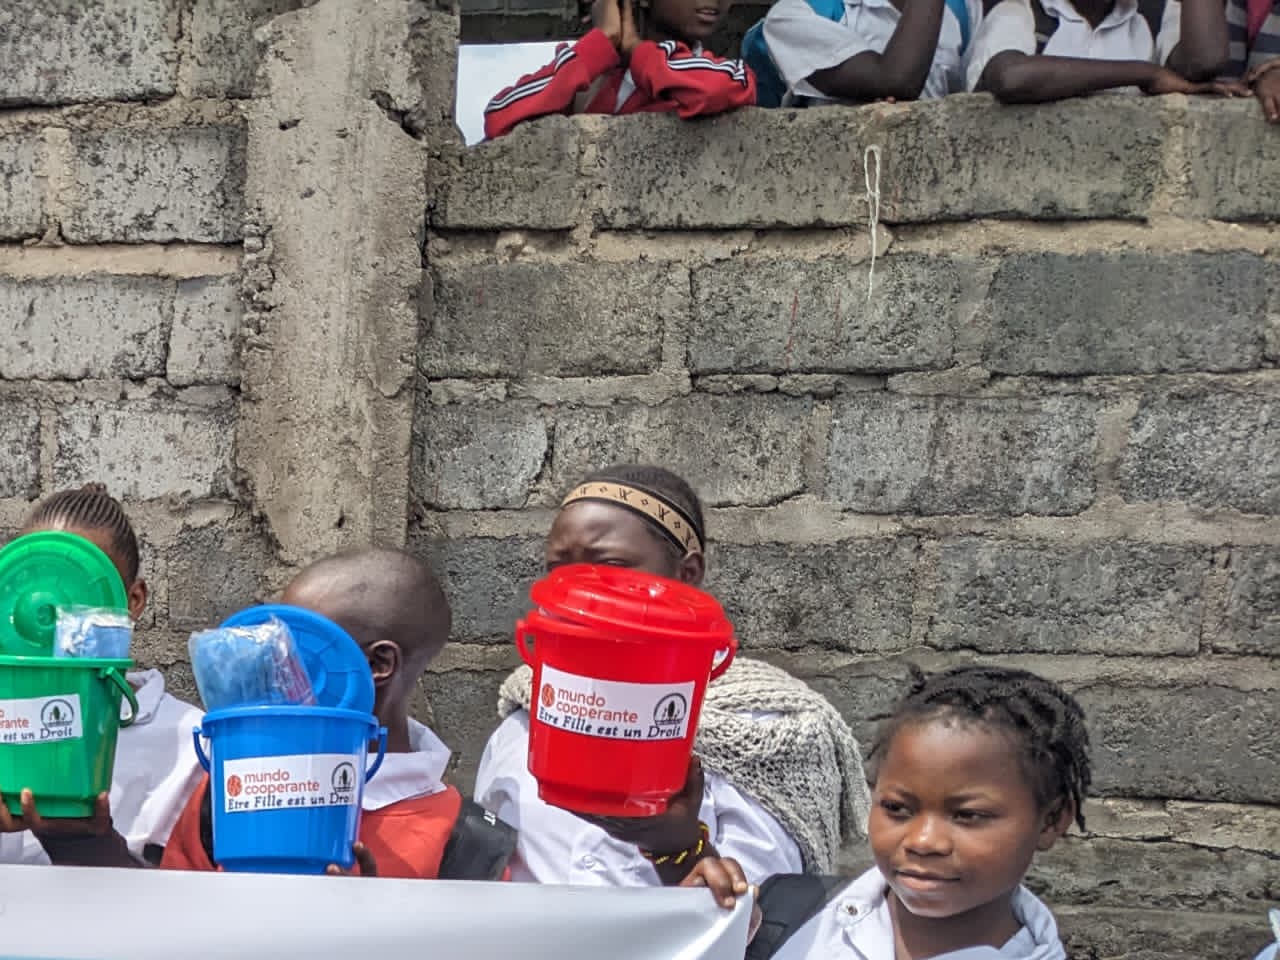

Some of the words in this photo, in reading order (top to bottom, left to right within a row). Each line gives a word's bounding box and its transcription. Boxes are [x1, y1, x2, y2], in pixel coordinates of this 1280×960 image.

[557, 687, 606, 707] mundo
[556, 700, 638, 724] cooperante
[539, 706, 559, 724] Etre
[562, 715, 593, 732] Fille
[597, 725, 618, 737] est
[623, 727, 642, 738] un
[647, 725, 681, 738] Droit
[40, 727, 73, 739] Droit
[244, 769, 290, 783] mundo
[244, 780, 320, 796] cooperante
[228, 798, 250, 810] Etre
[253, 793, 282, 808] Fille
[287, 795, 305, 806] est
[311, 795, 325, 804] un
